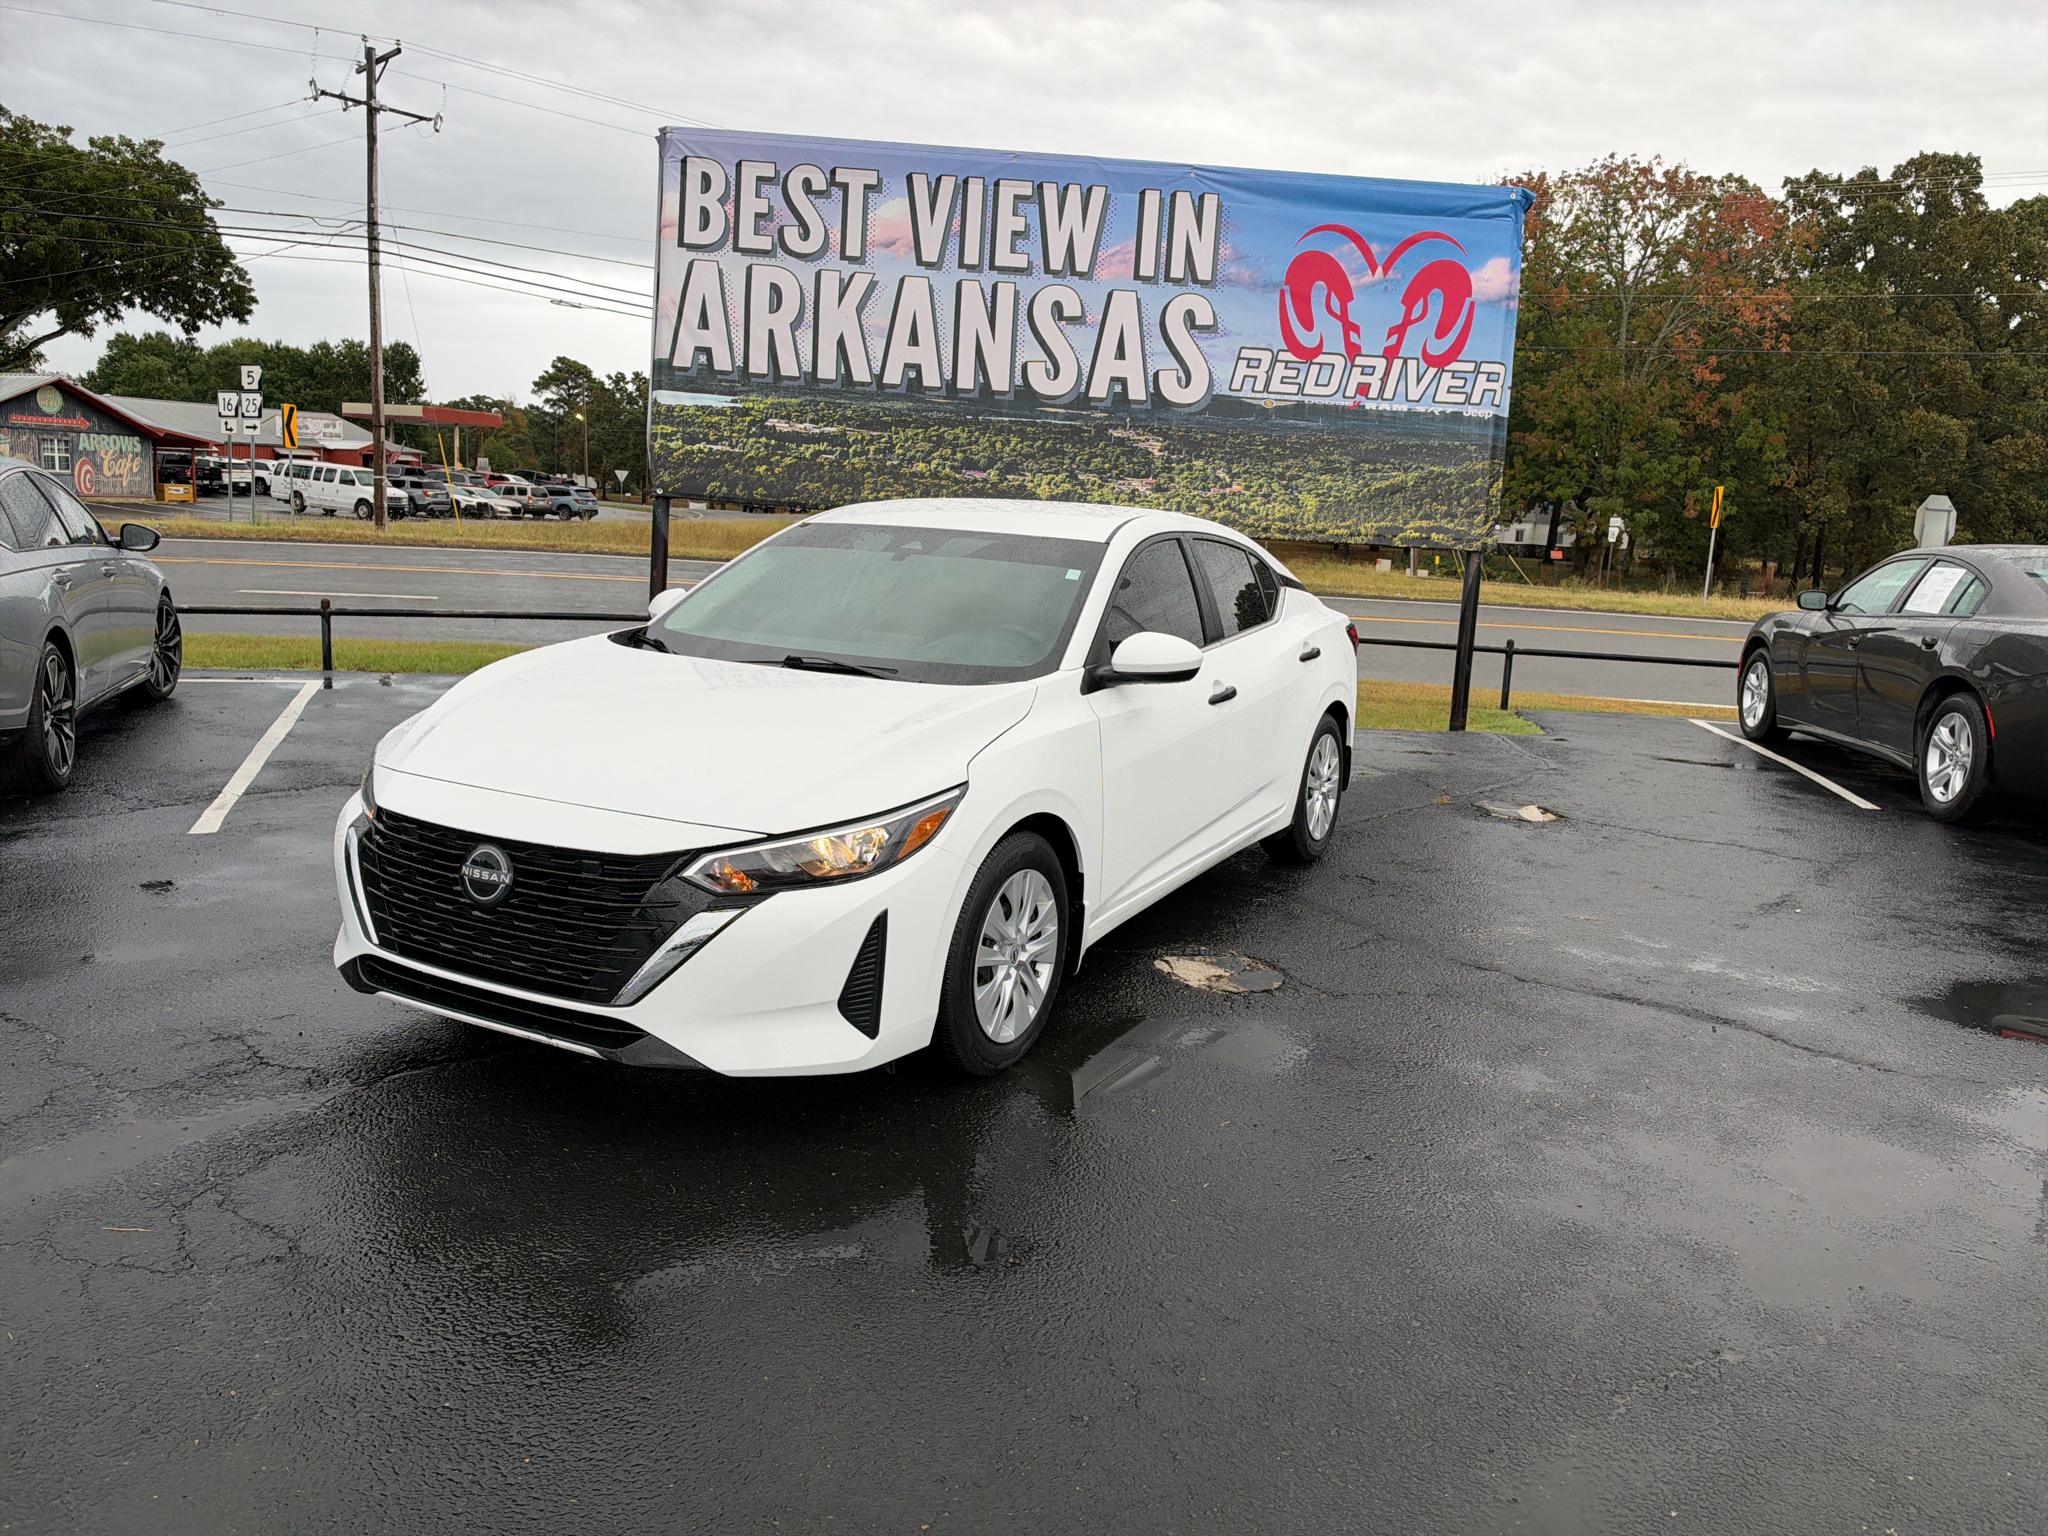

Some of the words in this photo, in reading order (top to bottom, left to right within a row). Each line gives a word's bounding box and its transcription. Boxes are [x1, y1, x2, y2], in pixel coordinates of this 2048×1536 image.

[678, 155, 881, 264] BEST
[905, 172, 1110, 280] VIEW
[1133, 188, 1223, 289] IN
[672, 259, 1218, 408] ARKANSAS
[247, 370, 255, 386] 5
[40, 389, 56, 399] EAT
[222, 397, 233, 412] 16
[245, 397, 257, 413] 25
[1364, 402, 1408, 412] RAM
[1463, 406, 1493, 419] Jeep
[79, 432, 142, 452] ARROWS
[100, 448, 141, 487] Cafe
[462, 865, 510, 883] NISSAN
